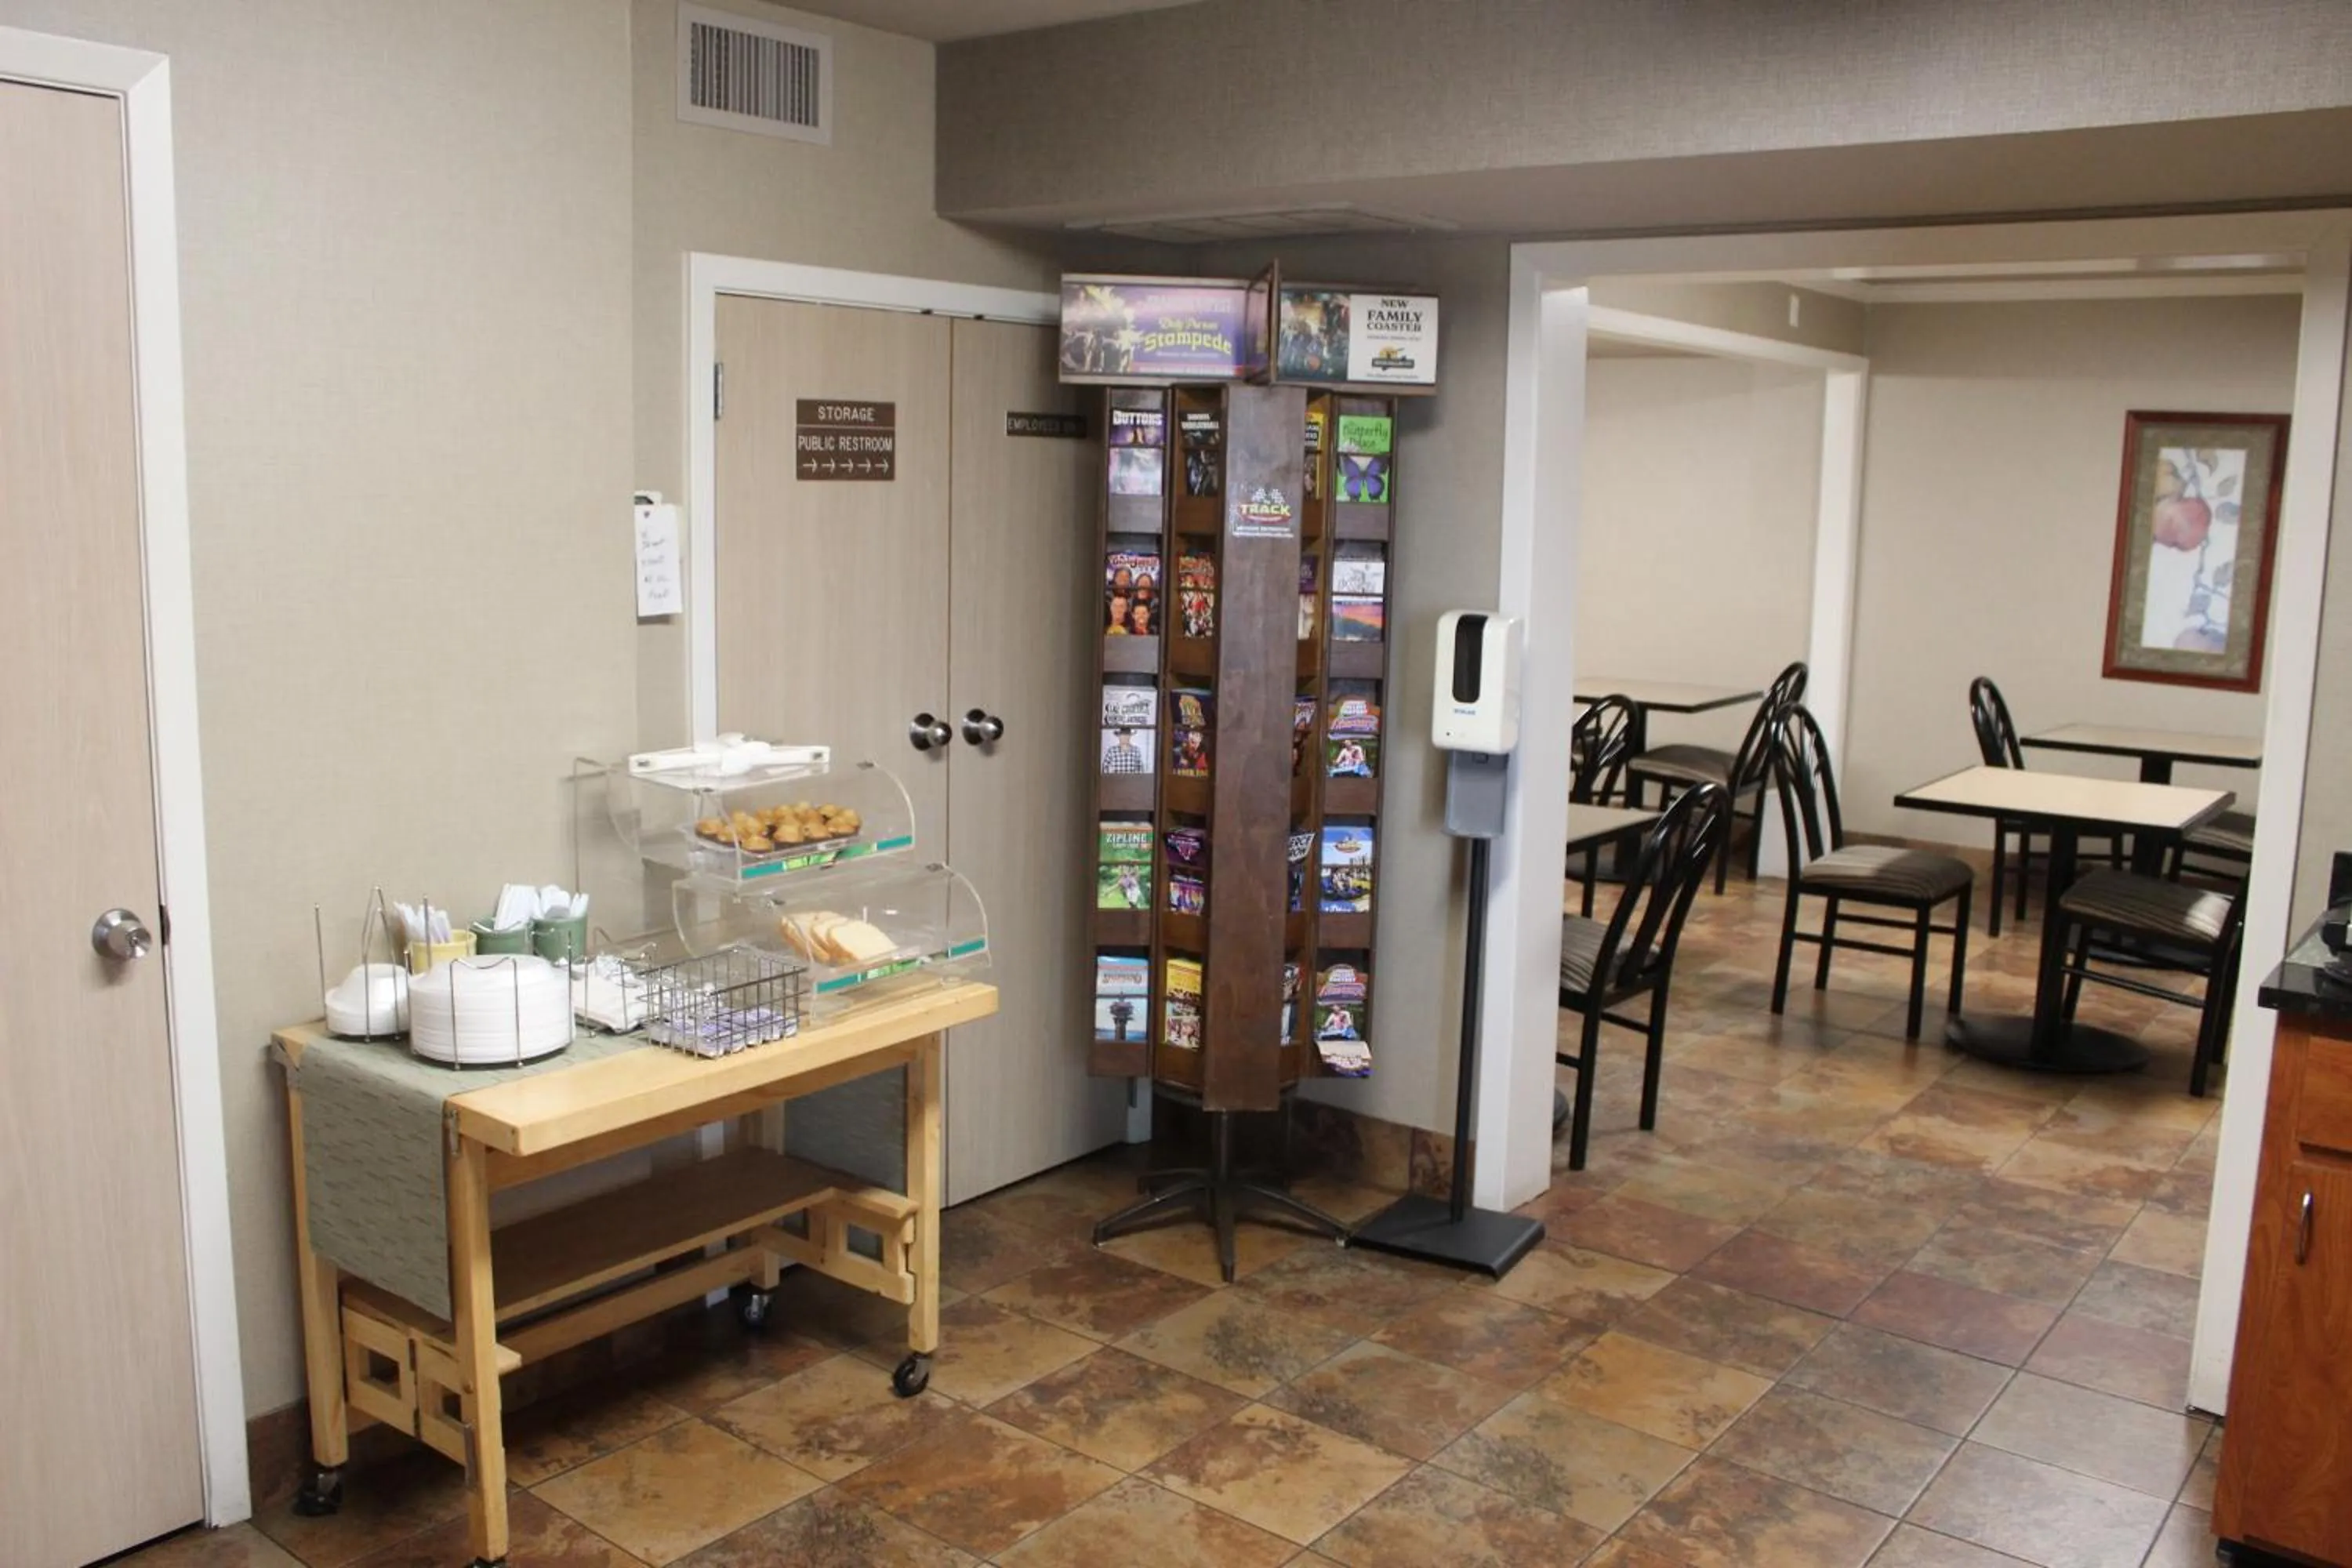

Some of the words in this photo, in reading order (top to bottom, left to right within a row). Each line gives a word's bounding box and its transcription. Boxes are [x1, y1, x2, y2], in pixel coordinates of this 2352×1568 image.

[1381, 299, 1409, 308] NEW
[1367, 310, 1422, 322] FAMILY
[1367, 322, 1422, 332] COASTER
[1145, 332, 1232, 355] Stampede
[818, 405, 876, 423] STORAGE
[798, 435, 835, 451] PUBLIC
[839, 436, 893, 452] RESTROOM
[1240, 504, 1291, 517] TRACK
